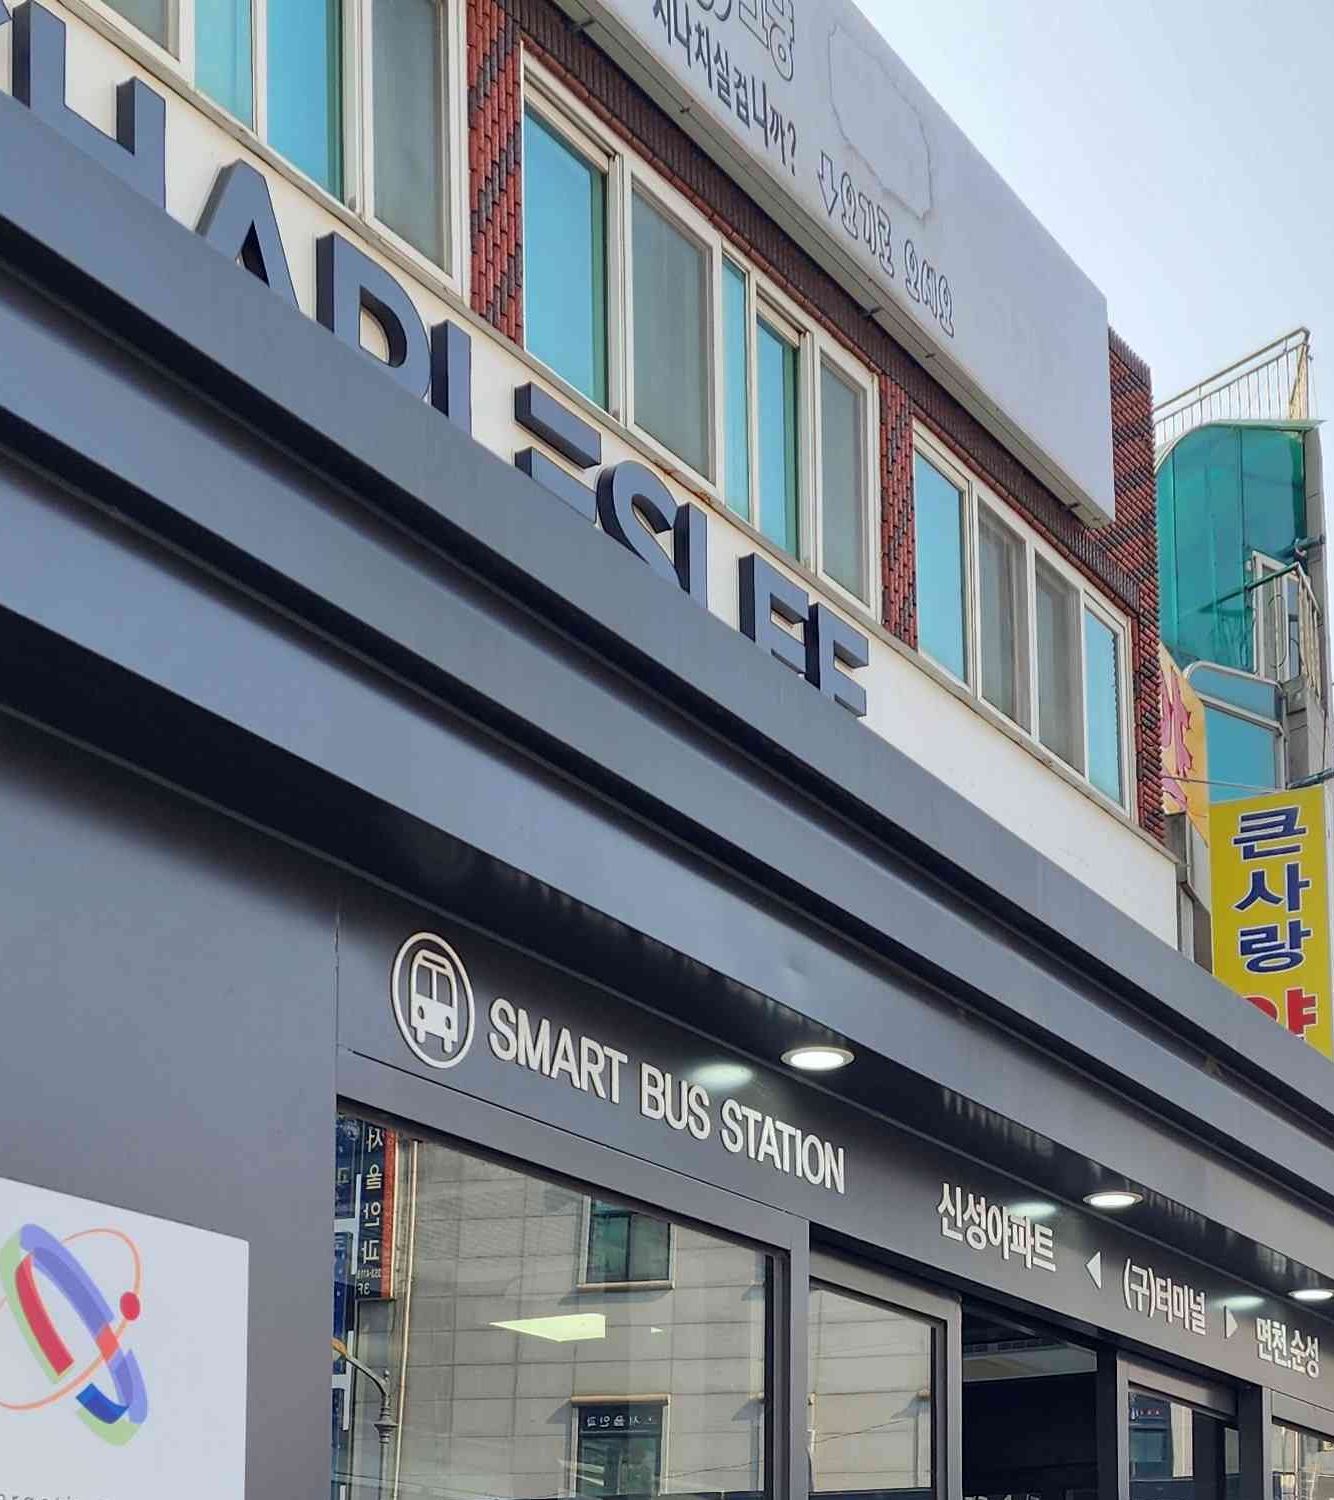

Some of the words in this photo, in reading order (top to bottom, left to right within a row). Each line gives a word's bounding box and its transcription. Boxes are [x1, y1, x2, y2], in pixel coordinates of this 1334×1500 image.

[487, 998, 627, 1104] SMART
[640, 1063, 710, 1141] BUS
[721, 1098, 845, 1194] STATION
[937, 1183, 1056, 1272] 신성아파트
[1123, 1258, 1207, 1336] (구)터미널
